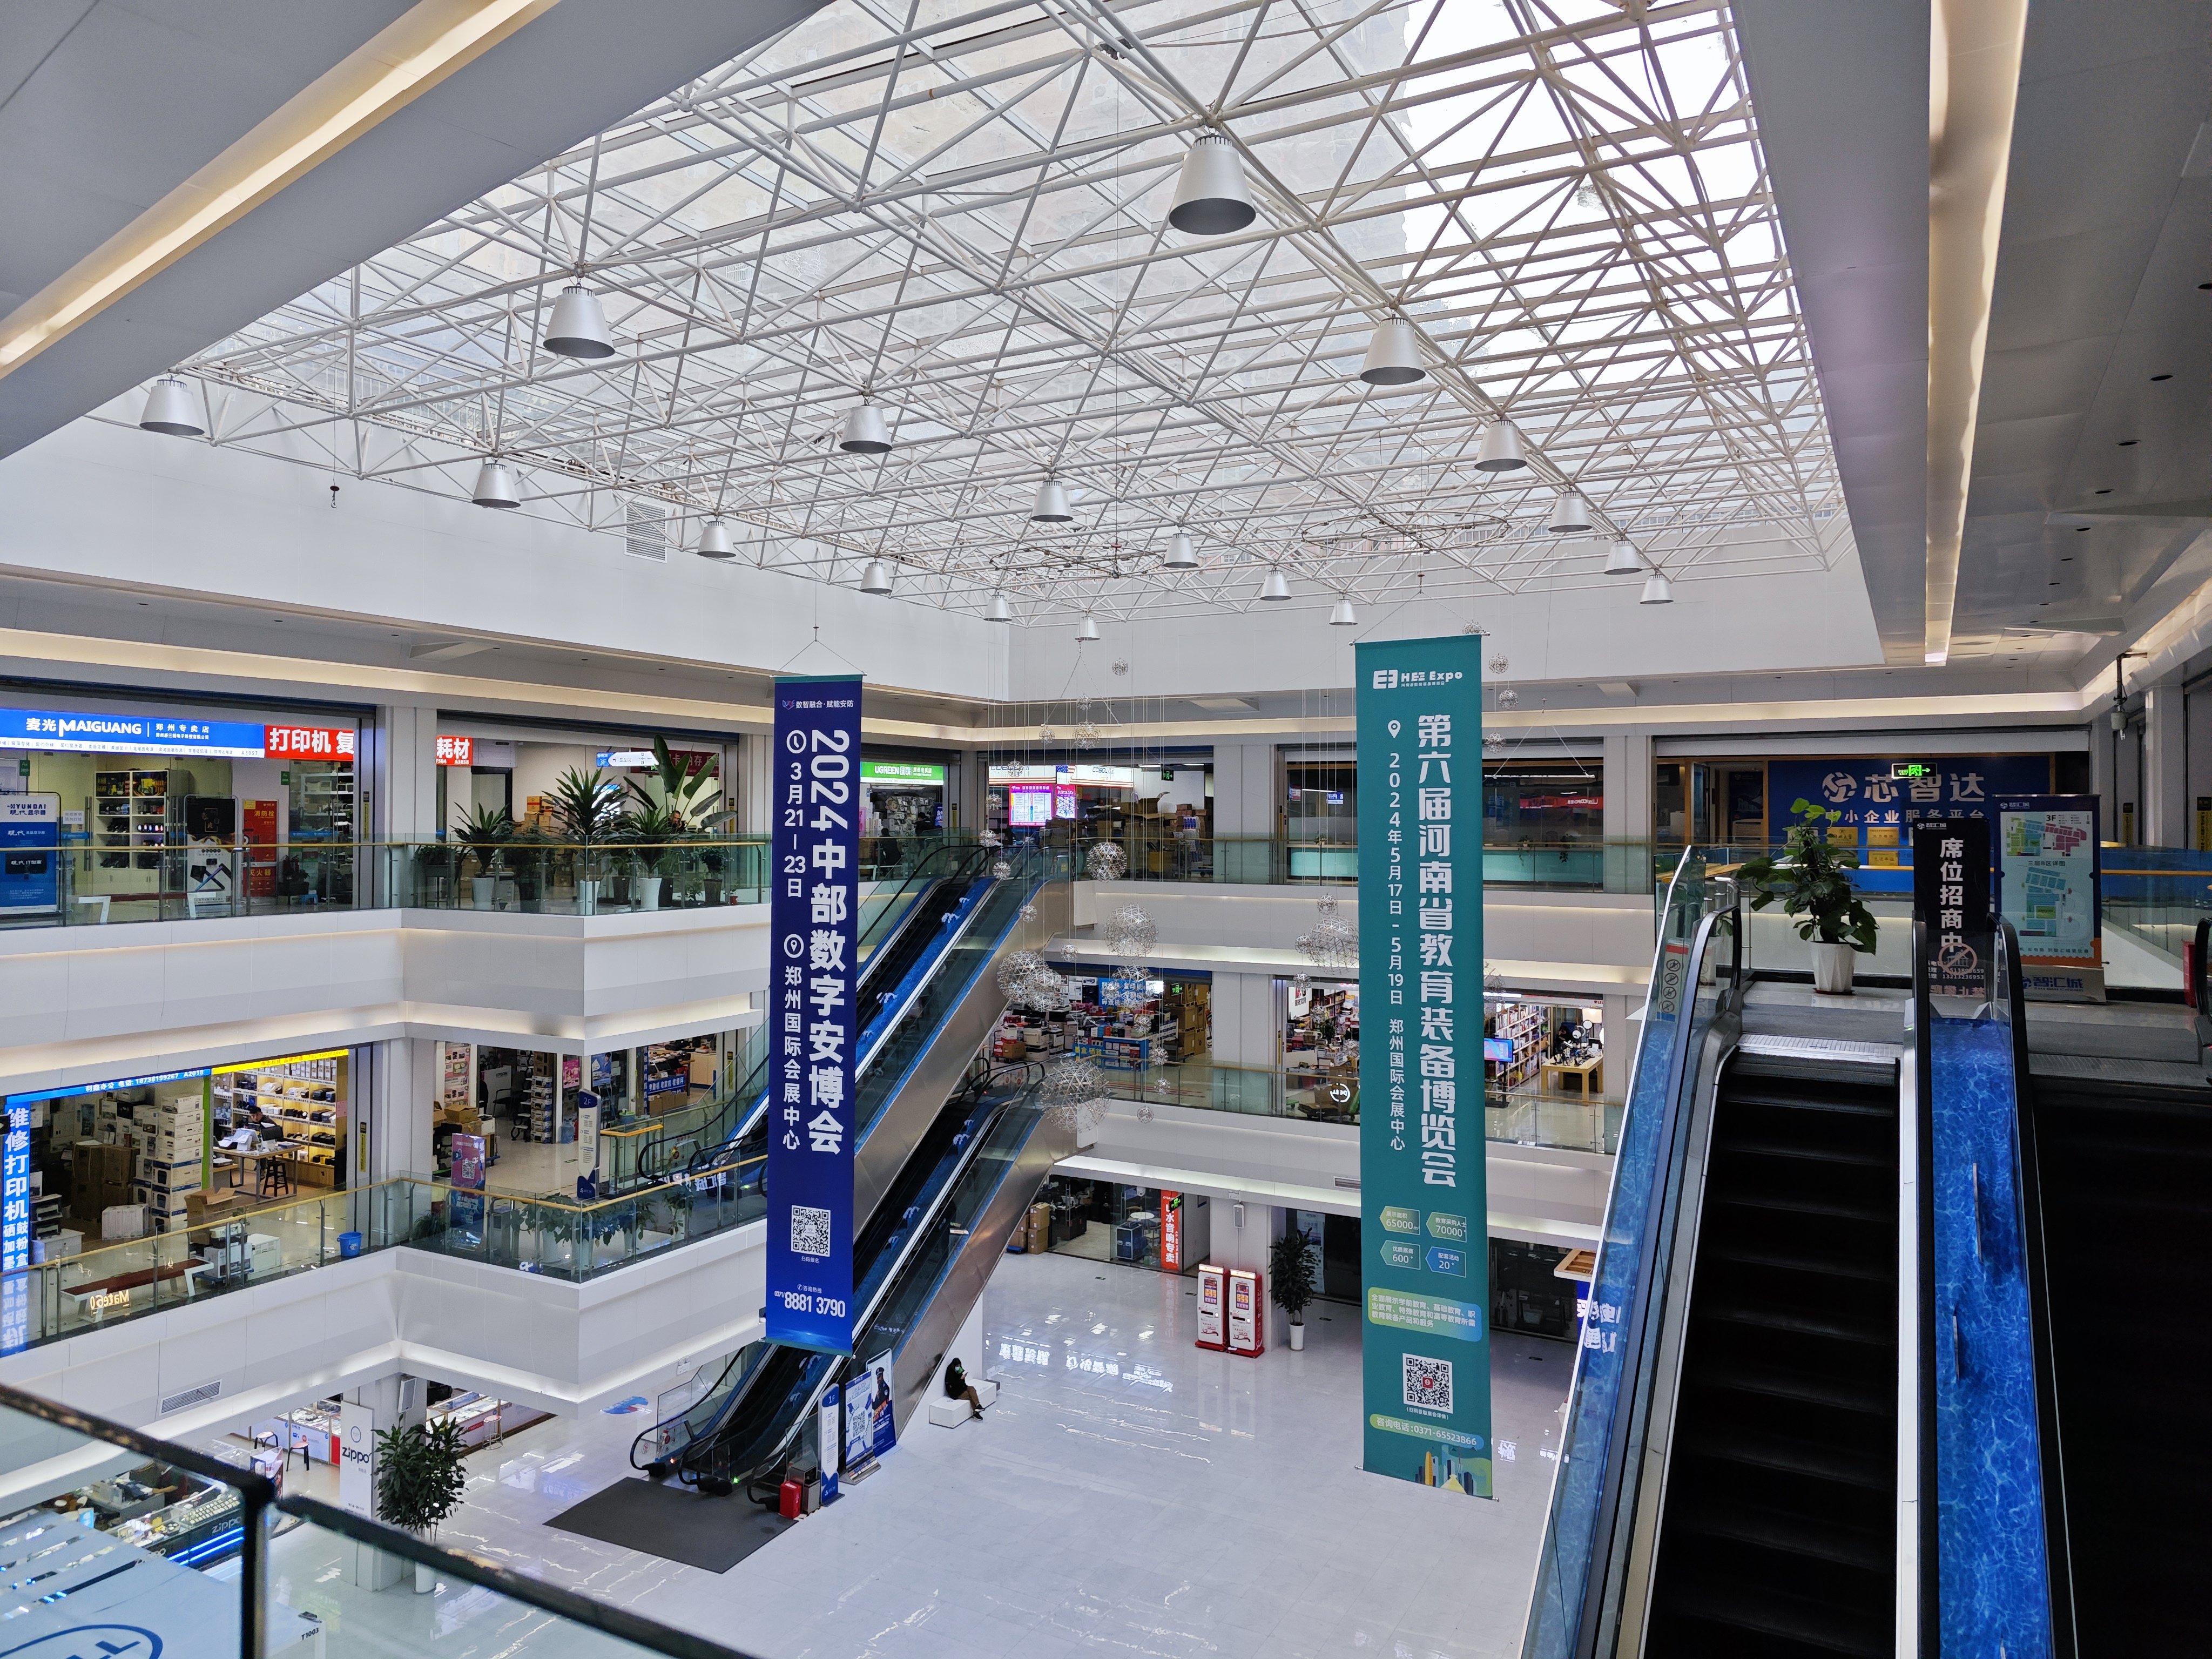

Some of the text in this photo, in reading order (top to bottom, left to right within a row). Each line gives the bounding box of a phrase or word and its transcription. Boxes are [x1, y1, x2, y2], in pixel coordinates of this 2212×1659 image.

[1429, 671, 1463, 683] Expo
[795, 700, 854, 709] 数智融合·赋能安防
[26, 717, 141, 737] 麦光 MAIGUANG
[156, 723, 210, 733] 郑州专卖店
[269, 727, 355, 754] 打印机 复
[436, 737, 470, 759] 耗材
[874, 765, 899, 774] UGREEN
[1864, 773, 1985, 803] 芯智达
[1939, 838, 1964, 953] 席位招商中
[807, 729, 850, 1155] 2024中部数字安博会
[1418, 714, 1456, 1188] 第六届河南省教育装备博览会
[2033, 976, 2084, 989] 智汇城
[783, 965, 802, 1150] 郑州国际会展中心
[136, 1073, 179, 1084] 18738199267
[183, 1070, 204, 1078] A2018
[1389, 1019, 1406, 1151] 郑州国际会展中心
[584, 1096, 591, 1105] 2F
[5, 1109, 29, 1222] 维修打印机
[1386, 1211, 1408, 1219] 展示面积
[1435, 1217, 1466, 1228] 教育采购人士
[4, 1222, 28, 1238] 硒鼓
[3, 1240, 28, 1255] 加粉
[1392, 1246, 1414, 1255] 优质展商
[3, 1254, 28, 1269] 墨盒
[801, 1256, 819, 1264] 扫码报名
[1438, 1252, 1460, 1262] 配套活动
[802, 1285, 822, 1294] 咨询热线
[815, 1297, 846, 1318] 3790
[1371, 1293, 1476, 1319] 全面展示学前教育、基础教育、职
[1371, 1303, 1476, 1327] 业教育、特殊教育和高等教育所需
[1371, 1310, 1434, 1328] 教育装备产品和服务
[828, 1395, 835, 1404] 1F
[1376, 1417, 1478, 1446] 咨询电话:0371-65523866
[300, 1627, 320, 1641] T1003
